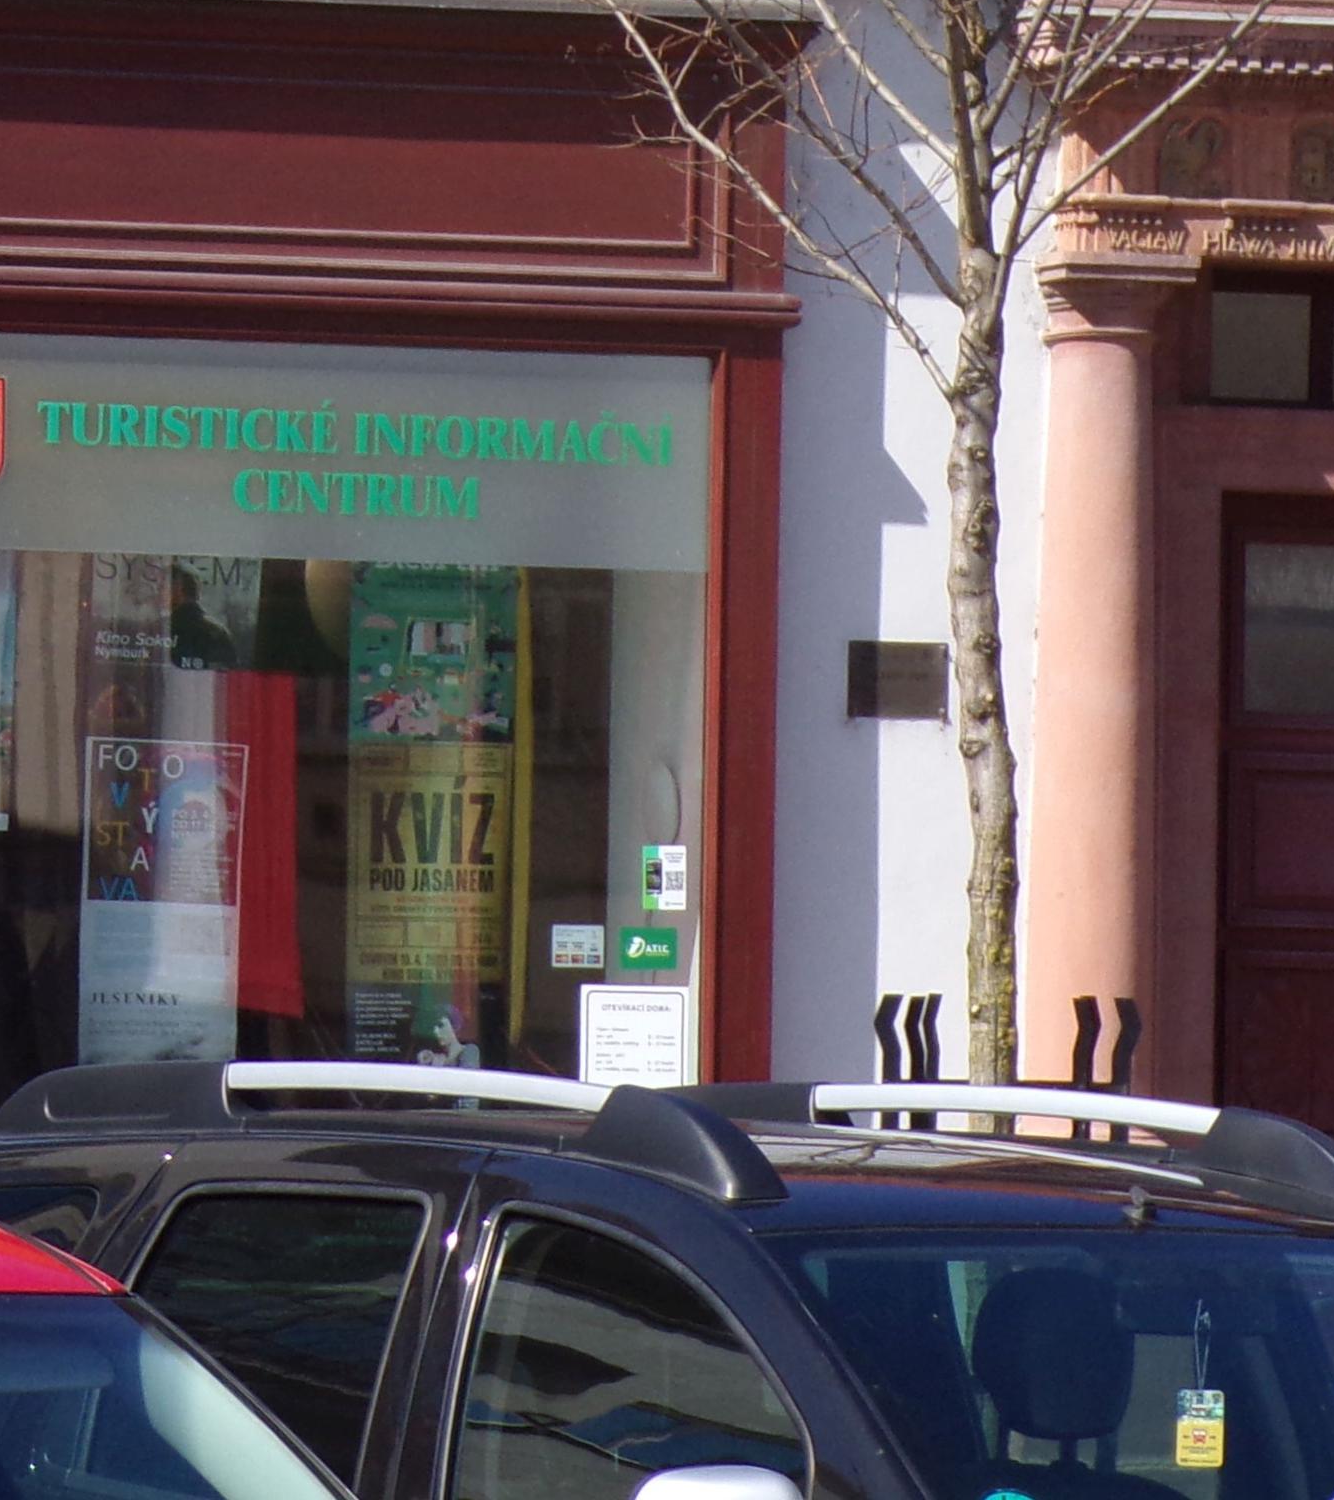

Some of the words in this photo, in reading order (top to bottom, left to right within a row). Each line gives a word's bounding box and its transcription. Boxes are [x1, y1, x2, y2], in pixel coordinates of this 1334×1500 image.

[38, 400, 338, 454] TURISTICKÉ
[354, 411, 673, 466] INFORMAČNÍ
[233, 469, 482, 519] CENTRUM
[370, 775, 495, 865] KVÍZ
[369, 868, 406, 892] POD
[412, 868, 495, 893] JASANEM
